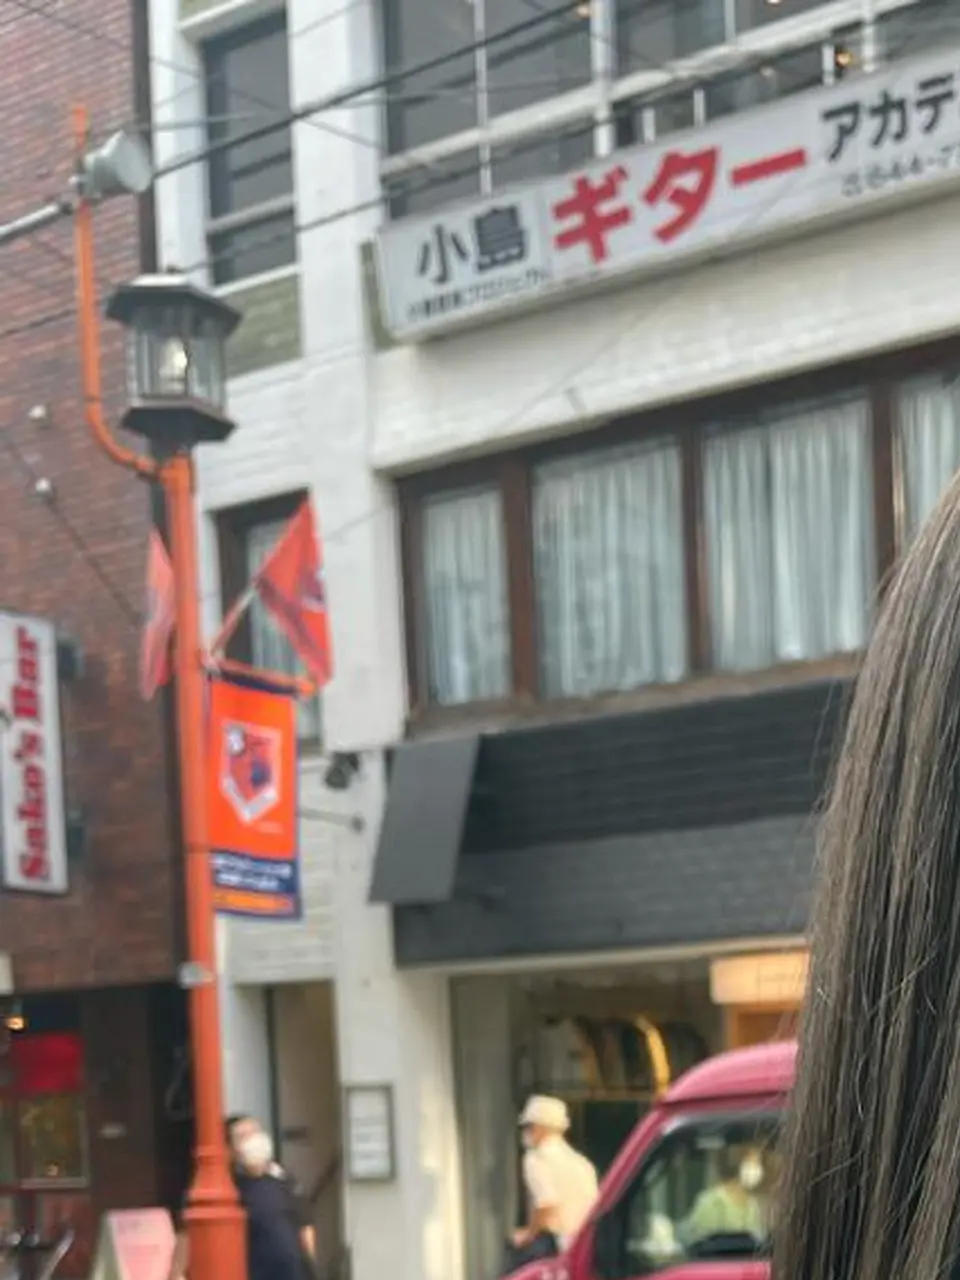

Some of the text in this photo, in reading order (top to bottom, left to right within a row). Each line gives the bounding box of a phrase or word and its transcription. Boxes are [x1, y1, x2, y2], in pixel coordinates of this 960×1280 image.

[417, 206, 526, 284] 小島
[554, 142, 806, 263] ギター
